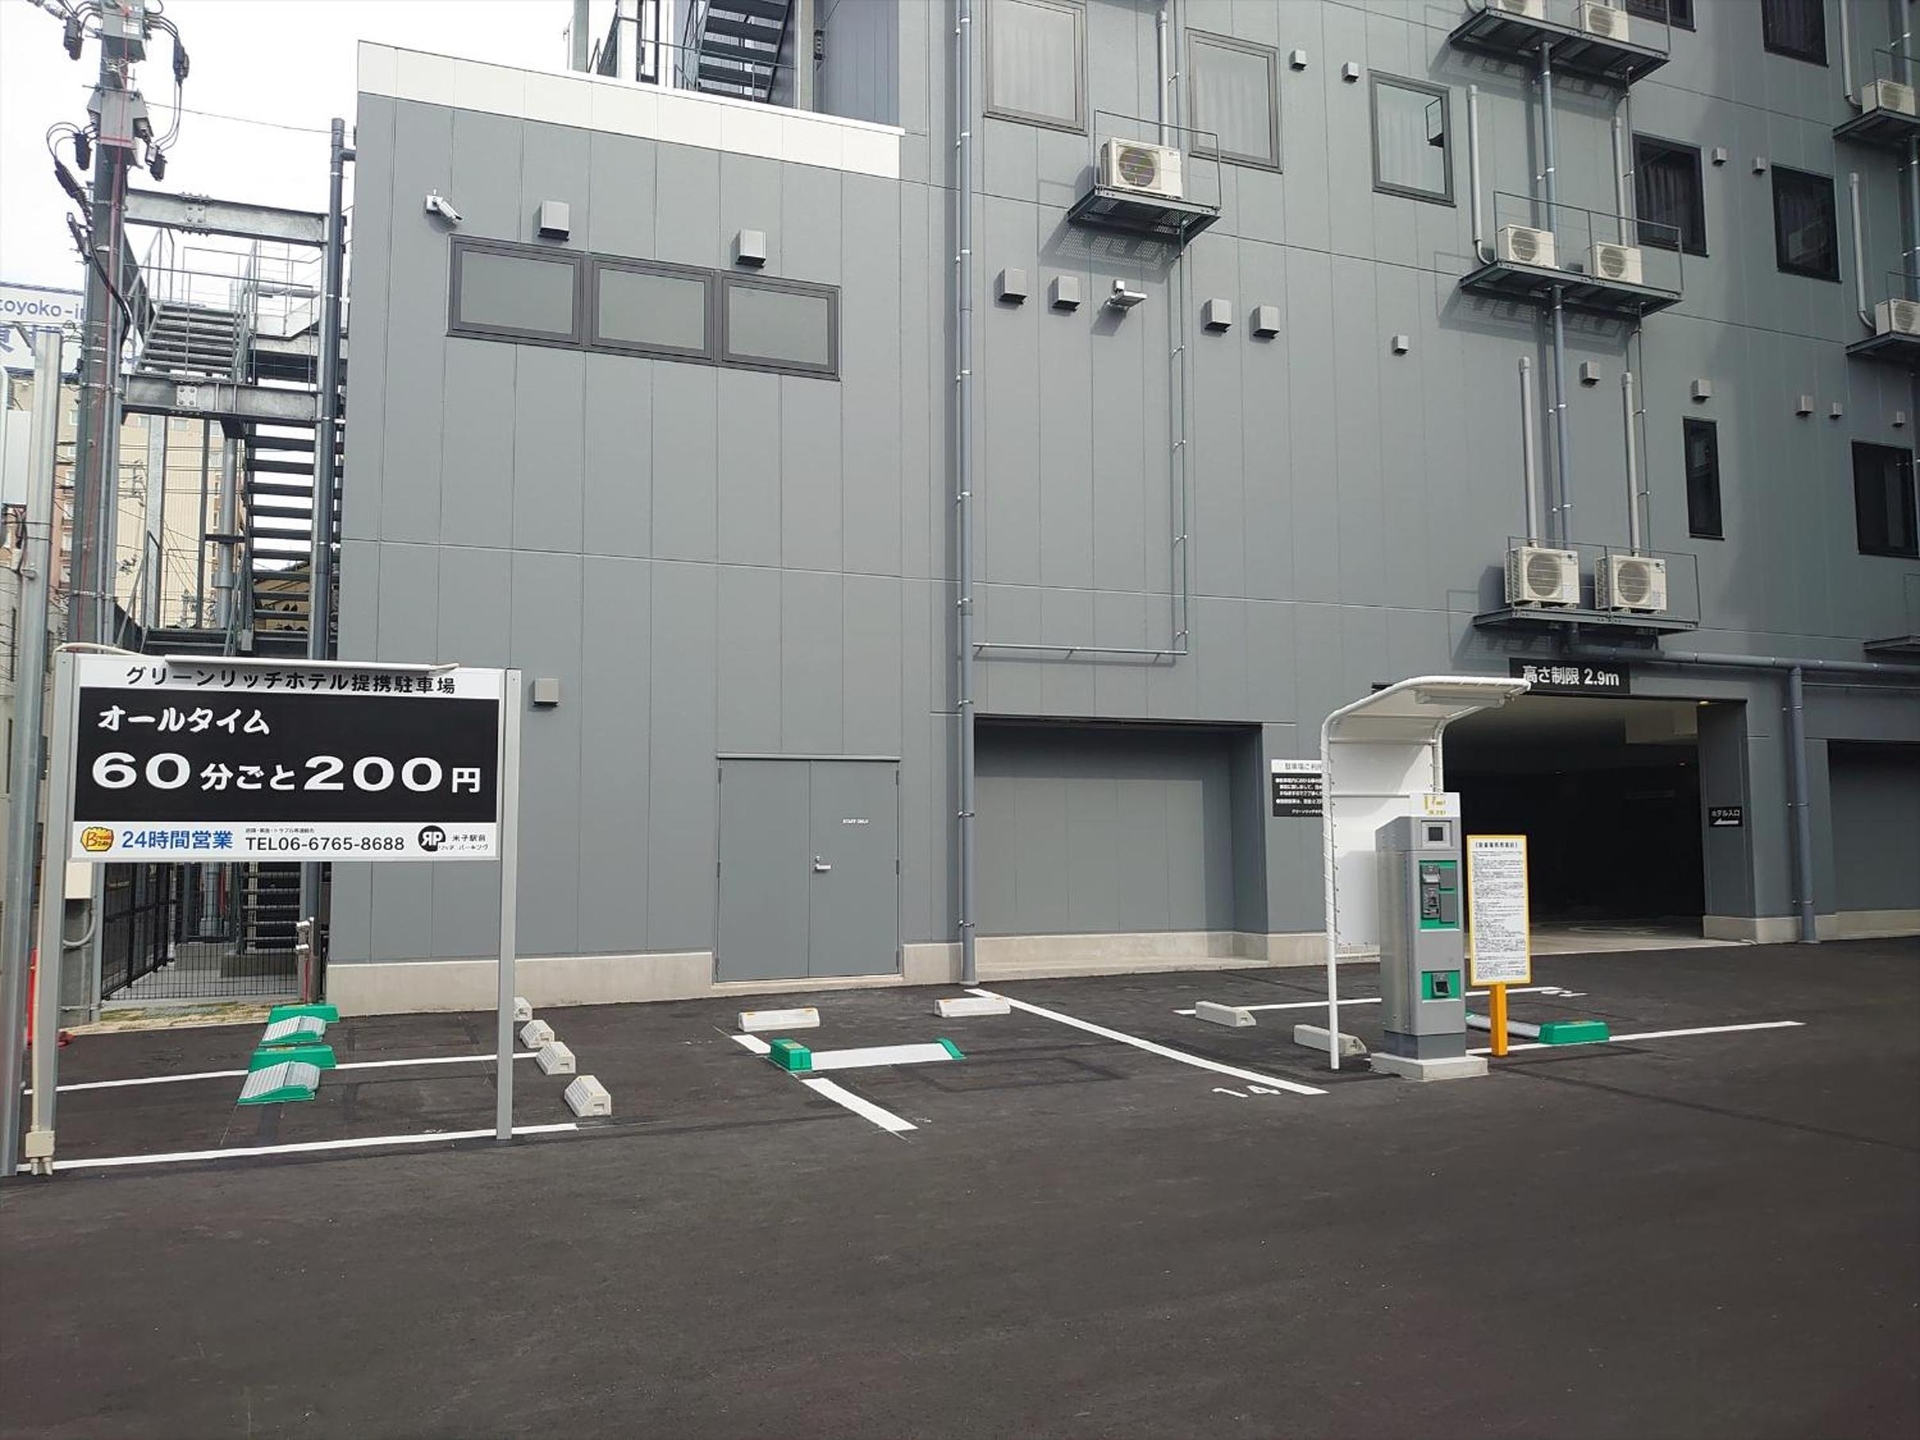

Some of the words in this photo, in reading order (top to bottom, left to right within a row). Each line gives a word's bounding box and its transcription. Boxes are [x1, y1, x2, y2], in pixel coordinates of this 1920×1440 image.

[126, 666, 456, 694] グリーンリッチホテル提携駐車場
[1522, 665, 1580, 685] 高さ制限
[1584, 668, 1619, 686] 2.9m
[98, 705, 270, 735] オールタイム
[92, 752, 482, 793] 60分ごと200円
[122, 830, 234, 849] 24時間営業
[245, 837, 405, 851] TEL06-6765-8688
